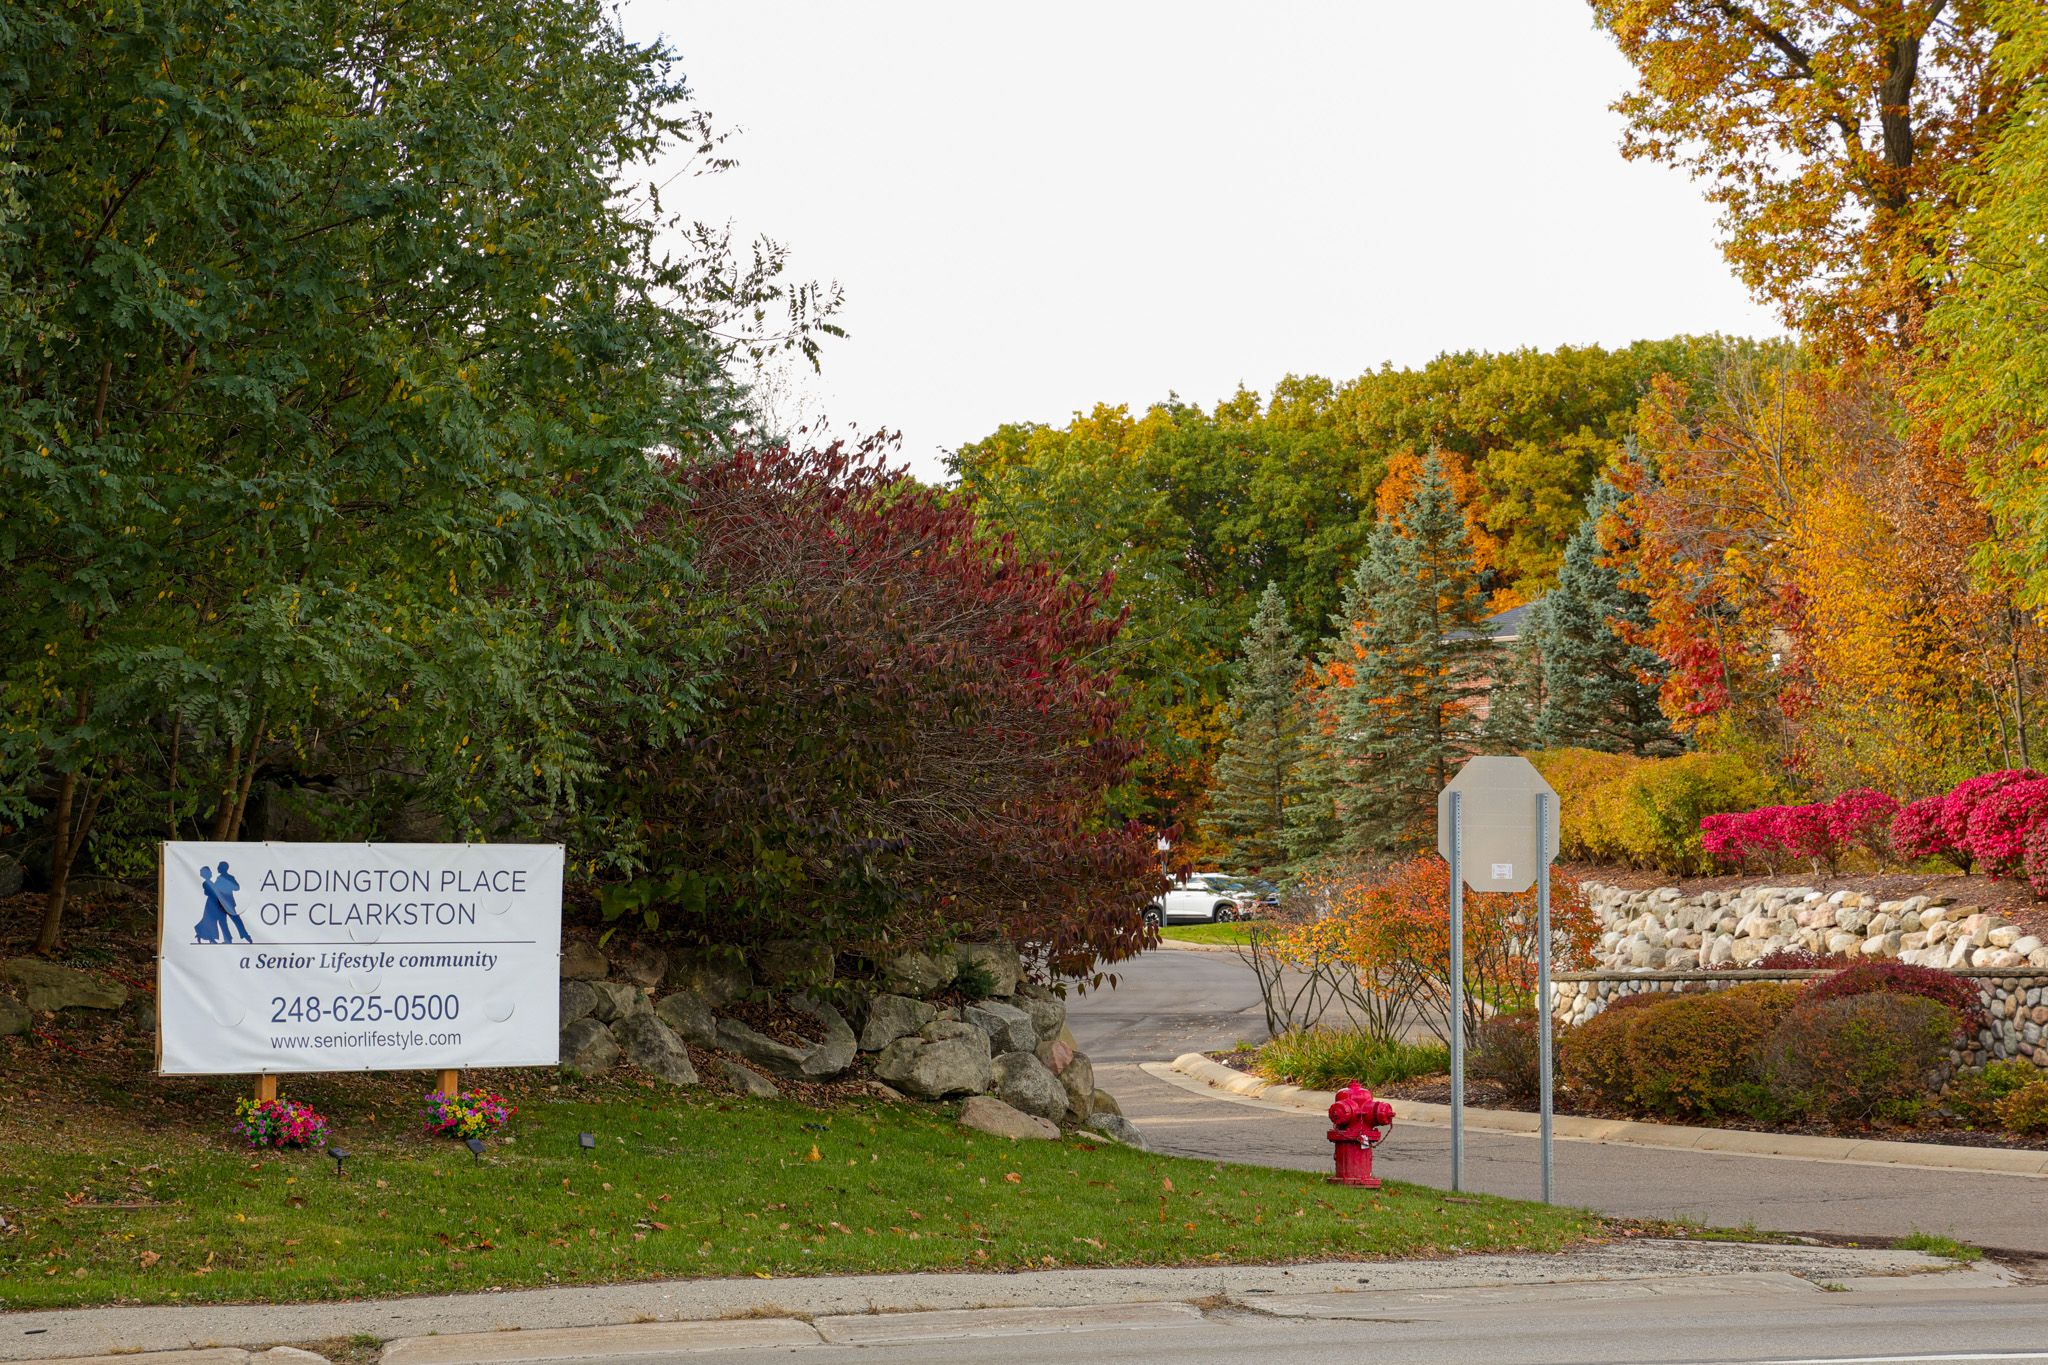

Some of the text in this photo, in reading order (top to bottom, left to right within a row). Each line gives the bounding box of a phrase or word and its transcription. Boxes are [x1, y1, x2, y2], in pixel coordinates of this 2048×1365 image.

[260, 869, 527, 893] ADDINGTON PLACE
[259, 902, 476, 926] OF CLARKSTON
[239, 951, 498, 973] a Senior Lifestyle community
[271, 994, 460, 1023] 248-625-0500
[271, 1031, 462, 1051] www.seniorlifestyle.com
